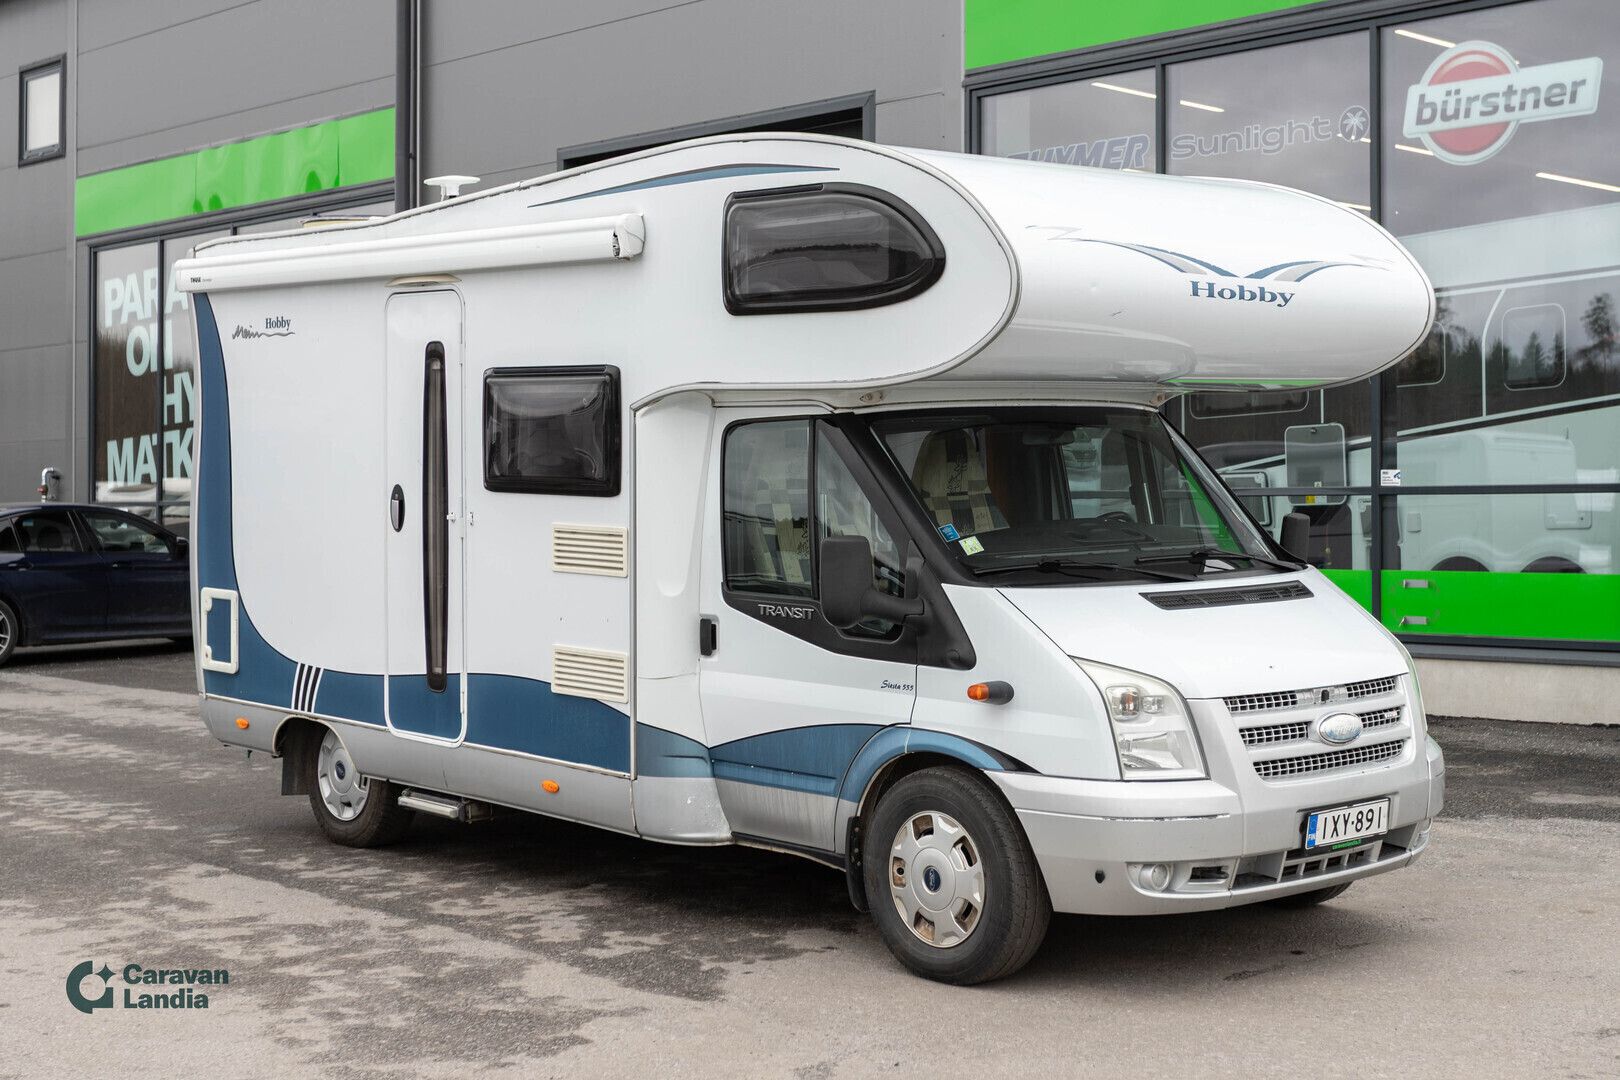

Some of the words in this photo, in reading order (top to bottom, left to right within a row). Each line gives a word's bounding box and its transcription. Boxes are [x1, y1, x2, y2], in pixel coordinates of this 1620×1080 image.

[1415, 79, 1587, 126] bürstner
[1171, 115, 1332, 160] Sunlight
[1189, 280, 1295, 308] Hobby
[265, 316, 292, 331] Hobby
[758, 604, 814, 620] TRANSIT
